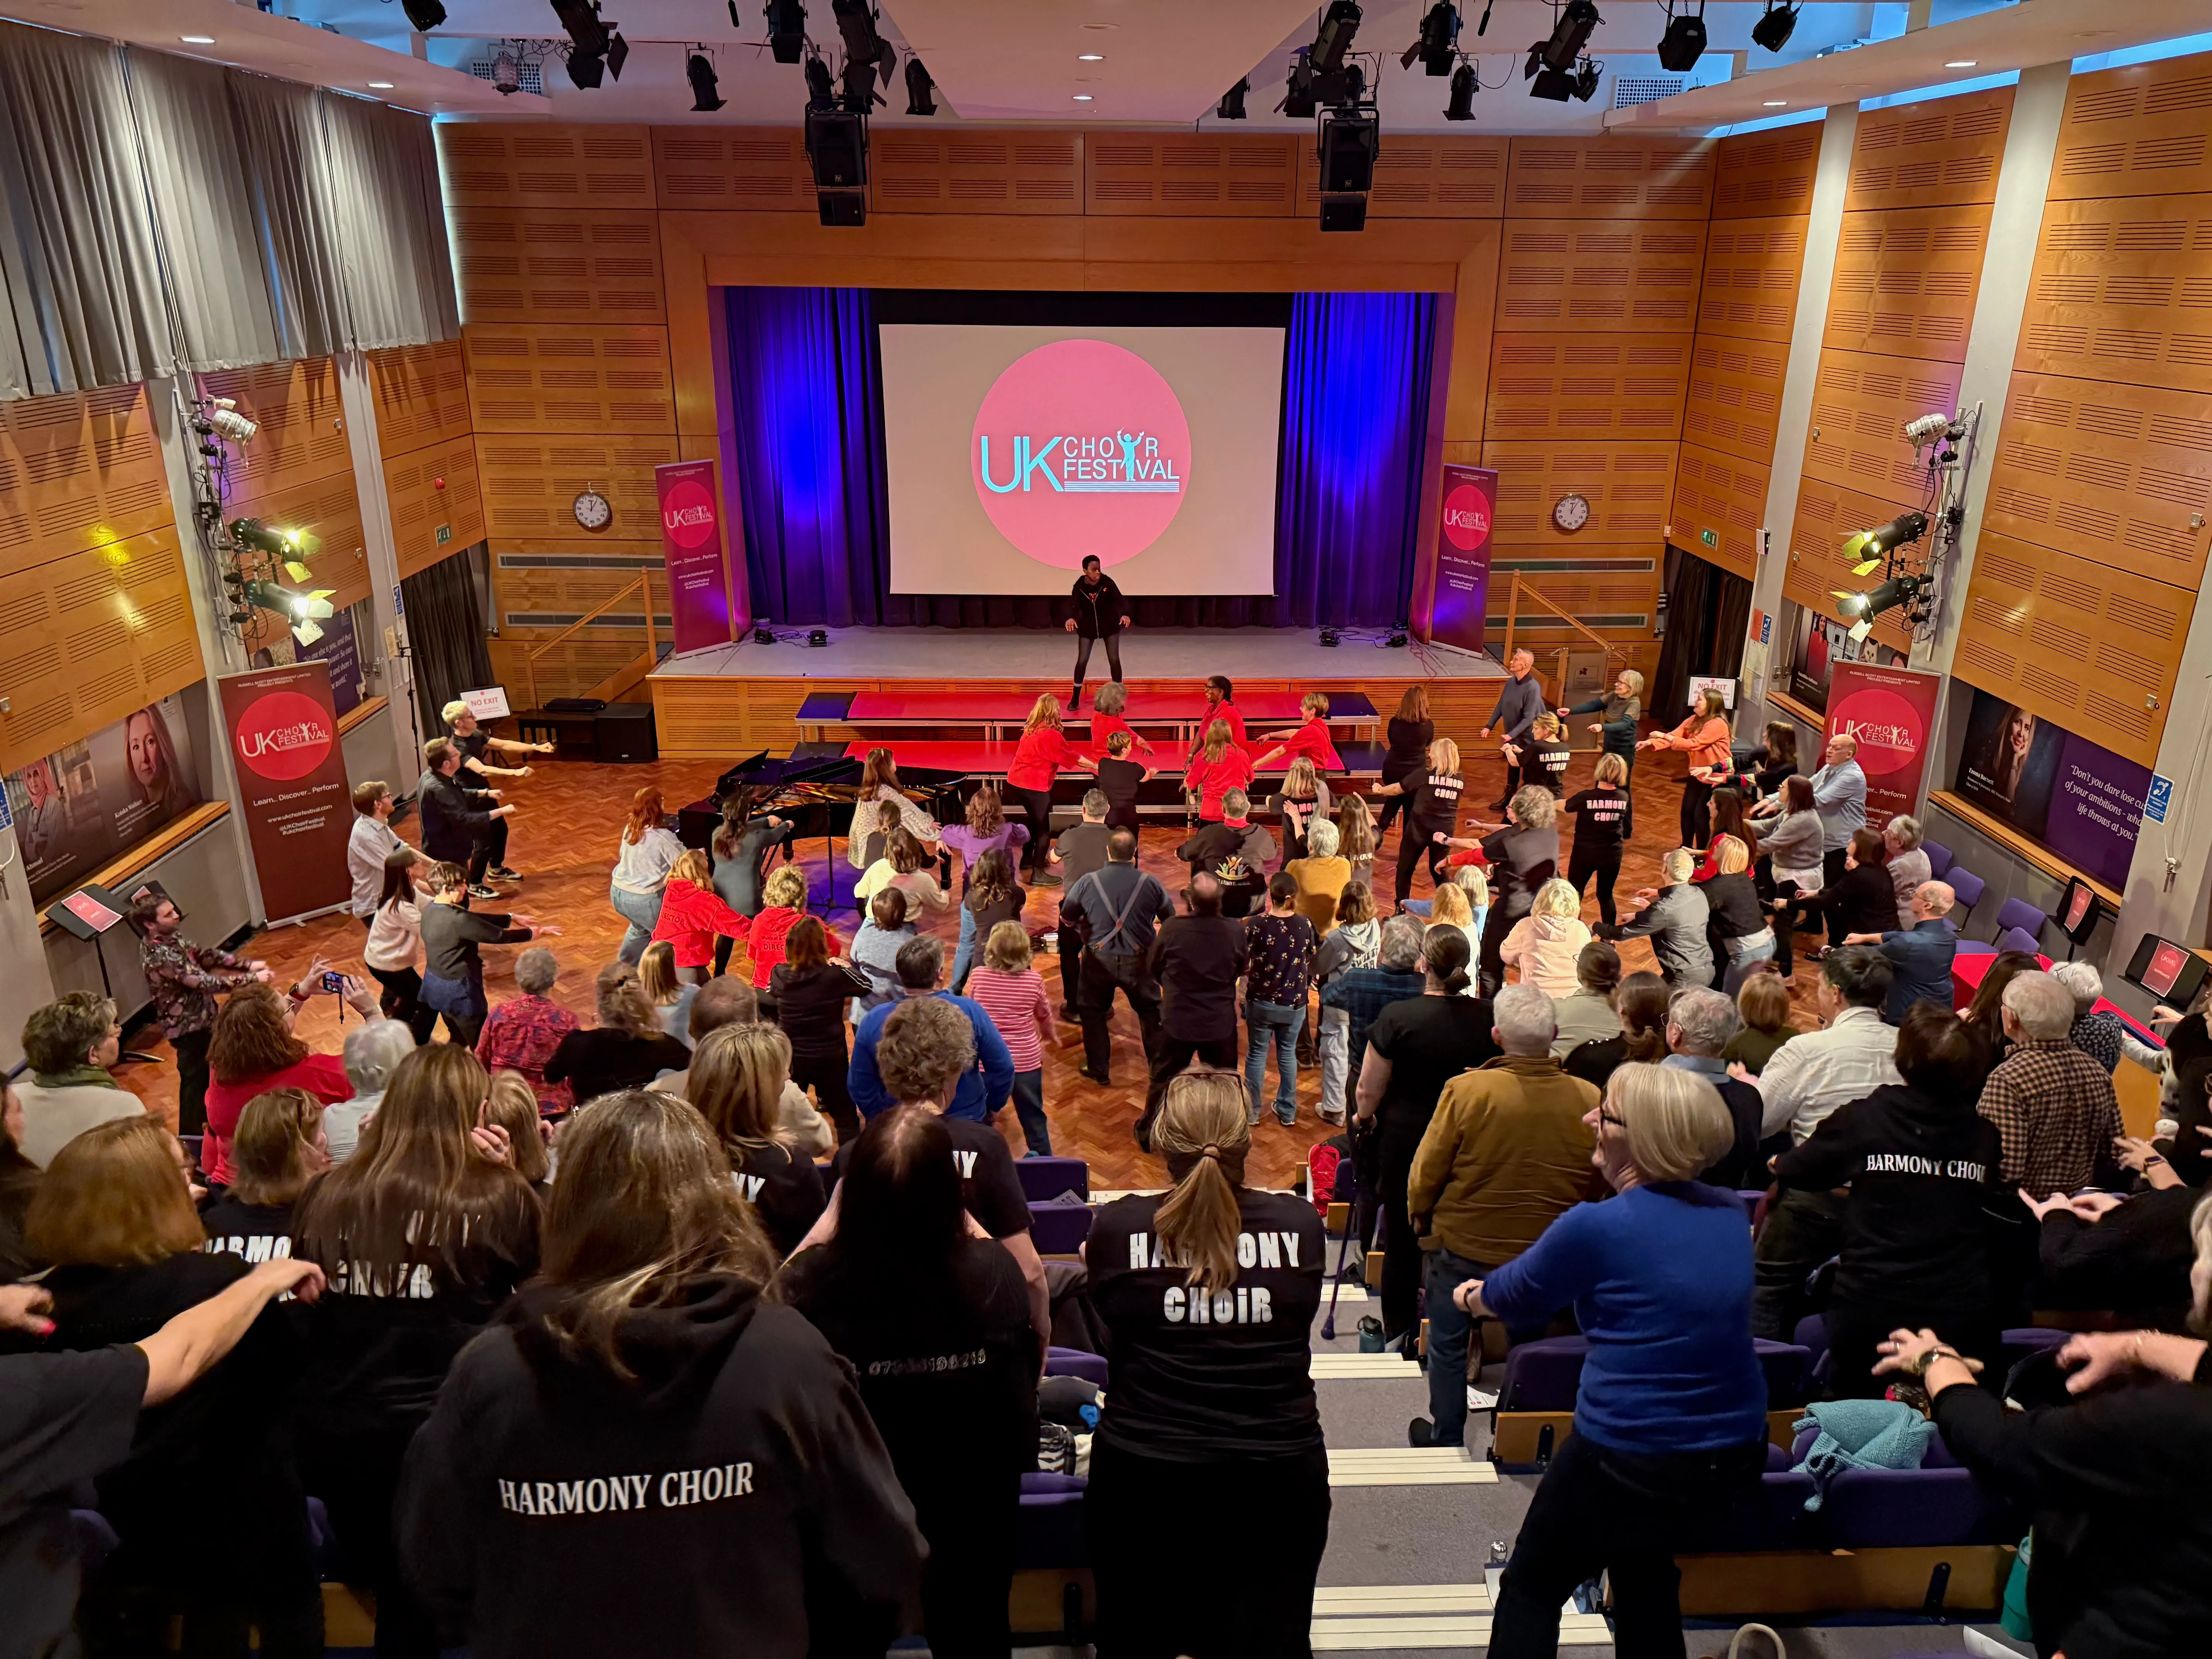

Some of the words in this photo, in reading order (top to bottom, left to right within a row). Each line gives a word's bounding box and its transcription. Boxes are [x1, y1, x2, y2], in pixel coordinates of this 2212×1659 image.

[981, 435, 1064, 493] UK
[1064, 459, 1180, 480] FESTIVAL
[665, 509, 687, 528] UK
[685, 511, 713, 522] FESTIVAL
[1445, 508, 1463, 527] UK
[1462, 517, 1488, 528] FESTIVAL
[278, 730, 329, 746] FESTIVAL
[1832, 717, 1868, 744] UK
[1865, 731, 1916, 747] FESTIVAL
[240, 730, 281, 757] UK
[312, 783, 339, 793] Perform
[1879, 788, 1907, 799] Perform
[2065, 781, 2074, 791] of
[2070, 784, 2089, 797] your
[2088, 793, 2122, 816] ambitions
[2088, 776, 2104, 788] you
[2104, 783, 2120, 797] dare
[2120, 790, 2135, 804] lose
[267, 804, 333, 823] www.ukchoirfestival.com
[2077, 802, 2088, 815] life
[2088, 809, 2111, 827] throws
[2111, 823, 2119, 832] at
[1865, 1154, 1942, 1176] HARMONY
[498, 1474, 653, 1515] HARMONY
[660, 1462, 755, 1507] CHOIR
